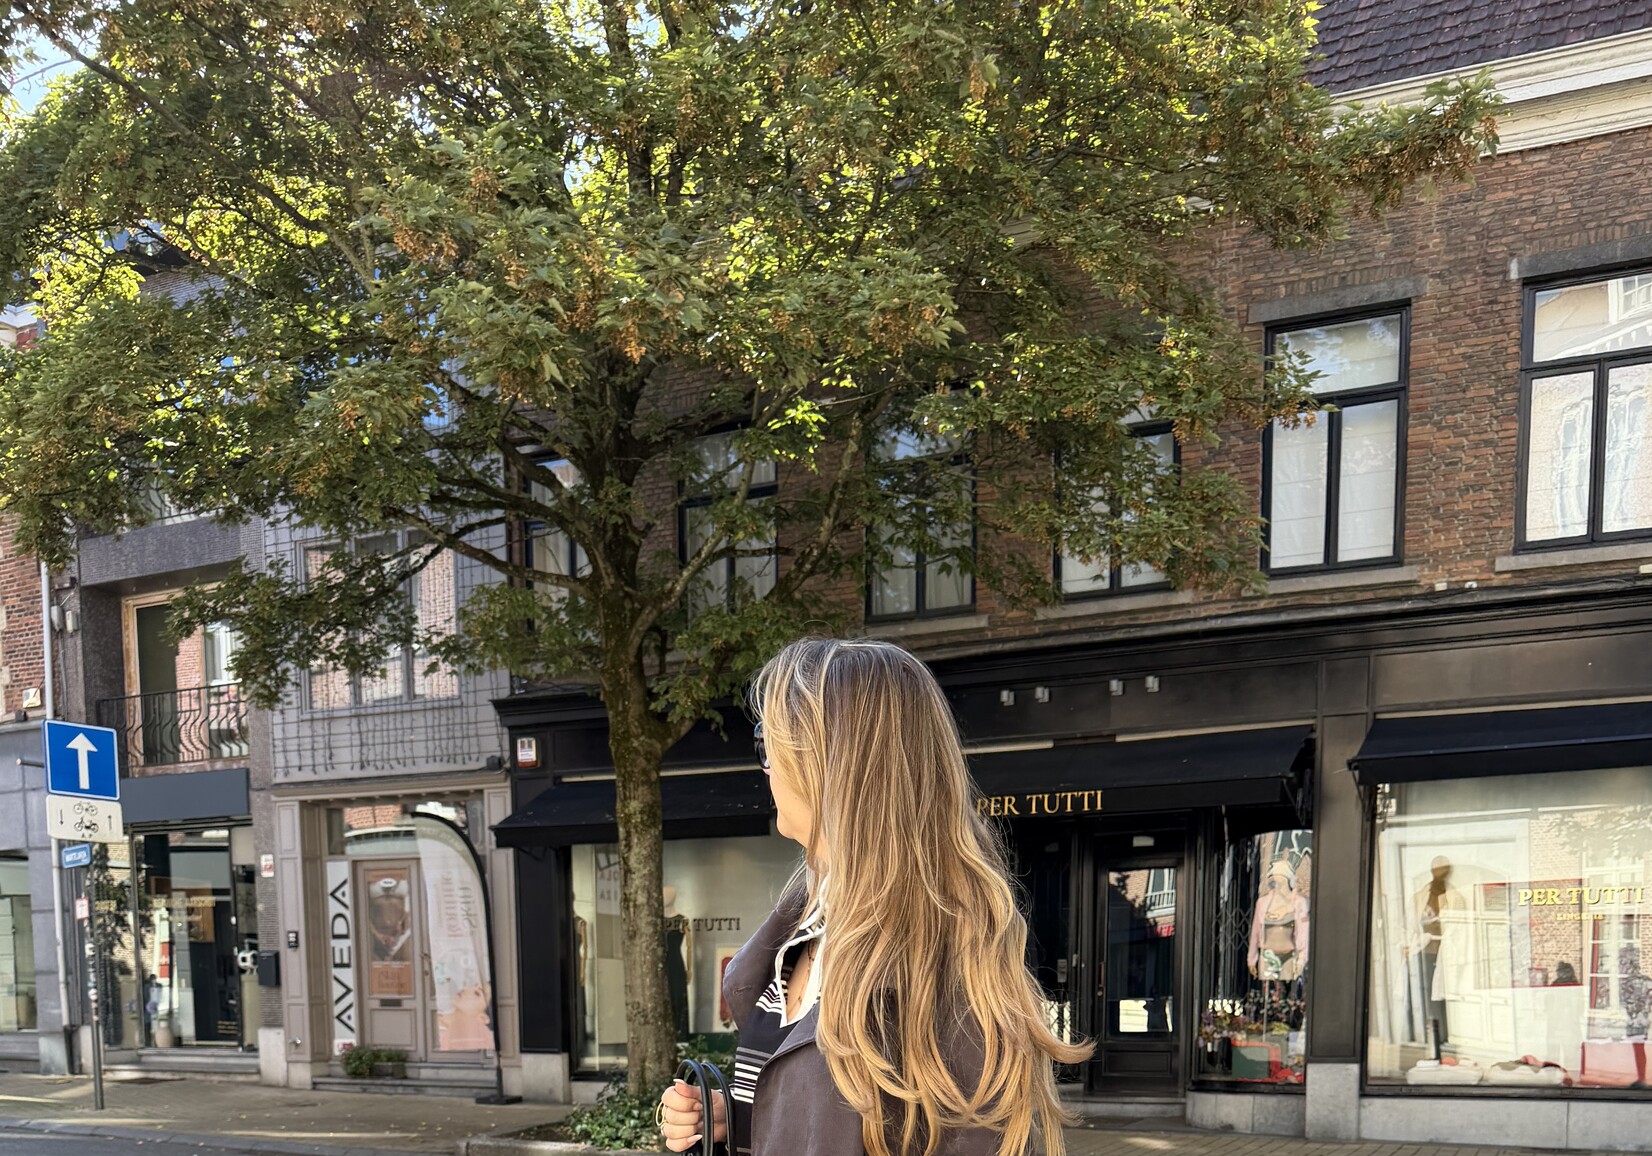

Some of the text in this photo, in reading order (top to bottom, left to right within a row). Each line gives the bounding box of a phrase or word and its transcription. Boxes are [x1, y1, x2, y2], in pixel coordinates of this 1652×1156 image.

[977, 789, 1103, 817] PER TUTTI
[1518, 886, 1646, 906] PER TUTTI
[693, 917, 741, 932] TUTTI
[328, 877, 356, 1033] AVEDA
